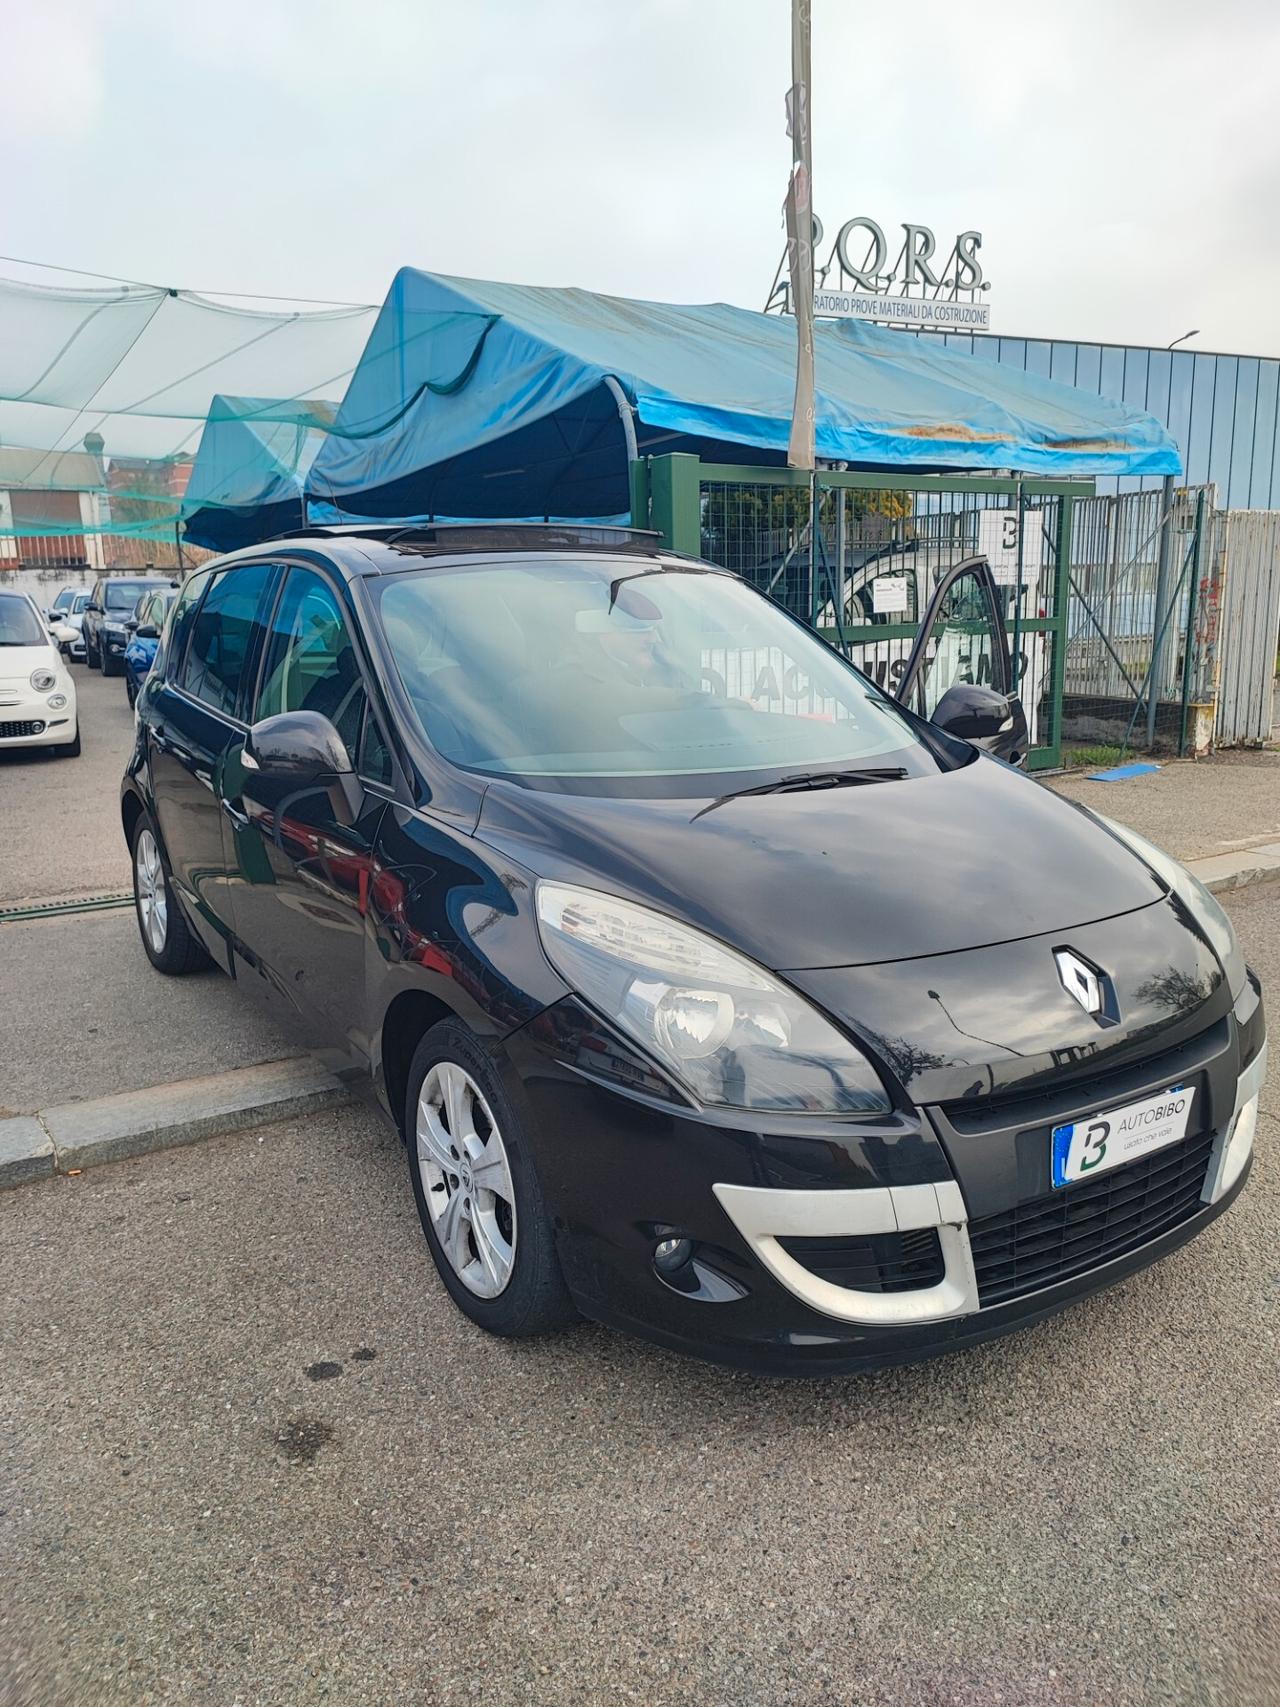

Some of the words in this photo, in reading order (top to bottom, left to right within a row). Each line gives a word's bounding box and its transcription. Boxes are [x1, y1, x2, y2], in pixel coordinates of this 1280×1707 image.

[792, 294, 850, 312] RATORIO
[851, 298, 878, 315] PROVE
[879, 301, 920, 319] MATERIALI
[921, 304, 933, 320] DA
[934, 305, 987, 325] COSTRUZIONE
[1117, 1099, 1185, 1135] AUTOBIBO
[1080, 1120, 1111, 1172] B
